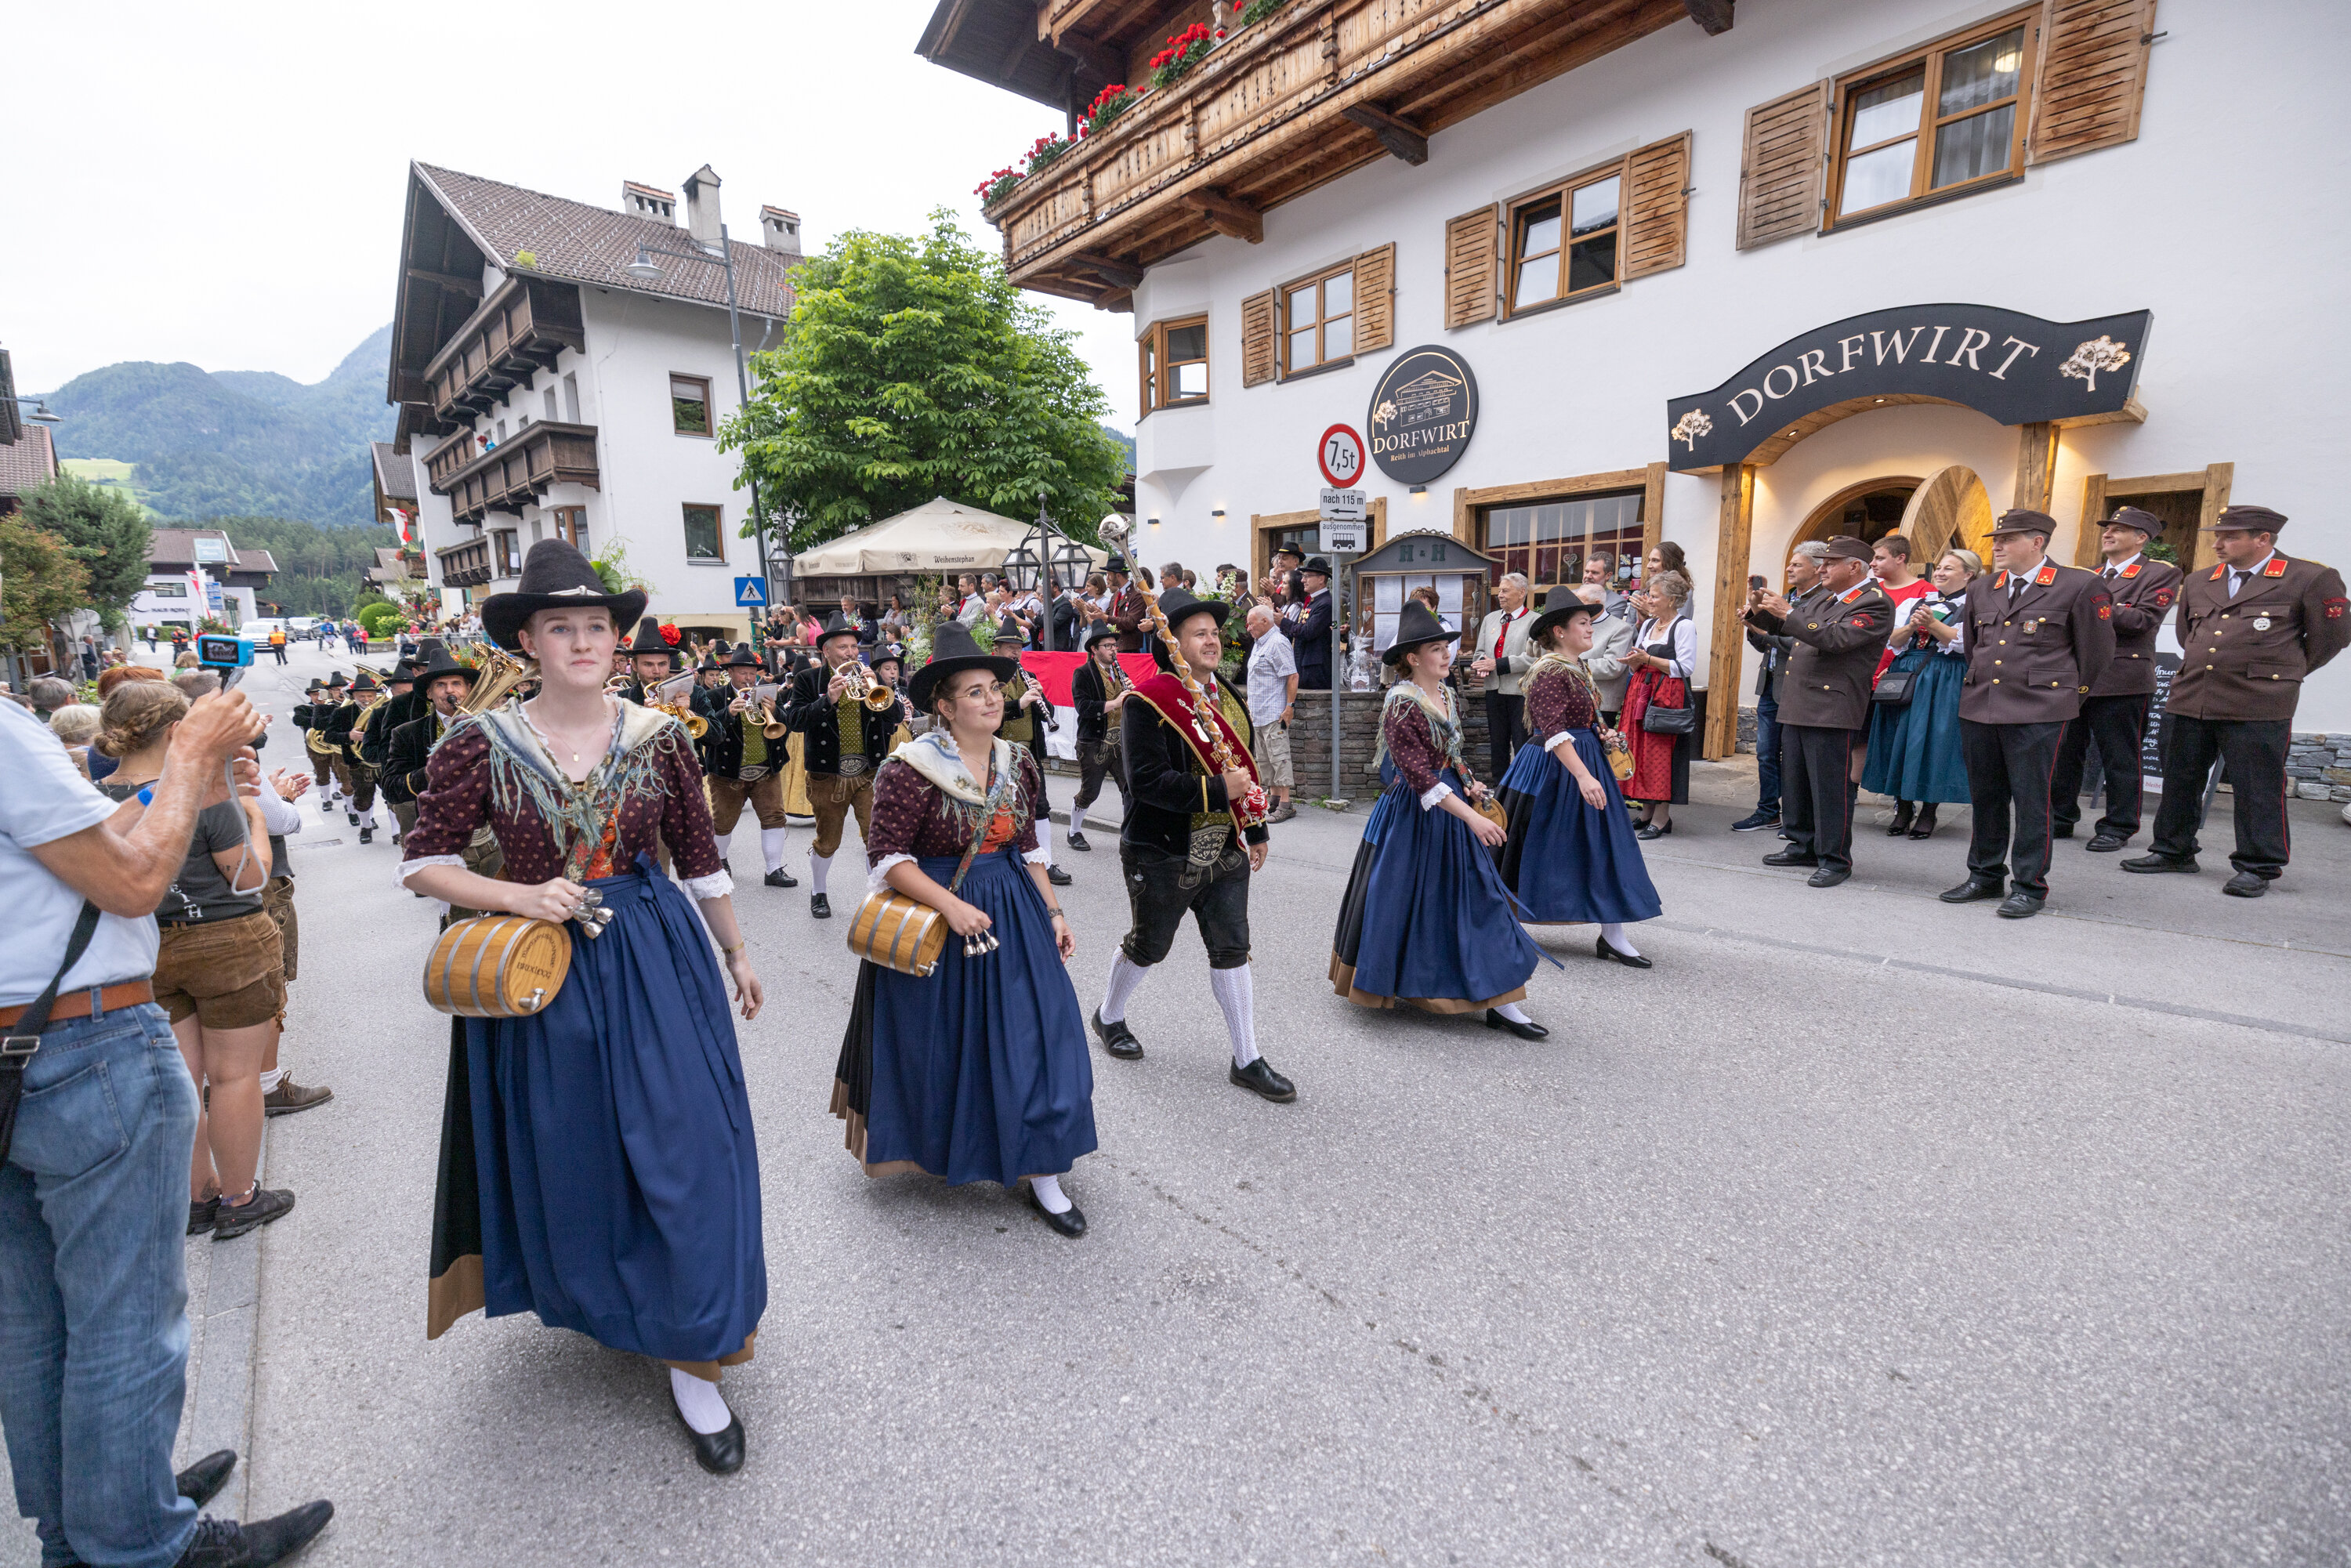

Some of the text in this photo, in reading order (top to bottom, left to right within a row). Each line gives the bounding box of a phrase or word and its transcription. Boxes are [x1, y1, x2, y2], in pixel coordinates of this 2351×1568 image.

[1726, 326, 2040, 427] DORFWIRT
[1373, 420, 1470, 454] DORFWIRT
[1390, 452, 1407, 462] Reith
[1417, 444, 1450, 458] Alpbachtal
[1323, 494, 1340, 505] nach
[1342, 494, 1355, 505] 115
[1322, 523, 1364, 531] ausgenommen
[933, 555, 975, 564] Weihenstephan
[1399, 545, 1414, 562] H
[1431, 544, 1446, 561] H
[169, 878, 204, 918] EITH
